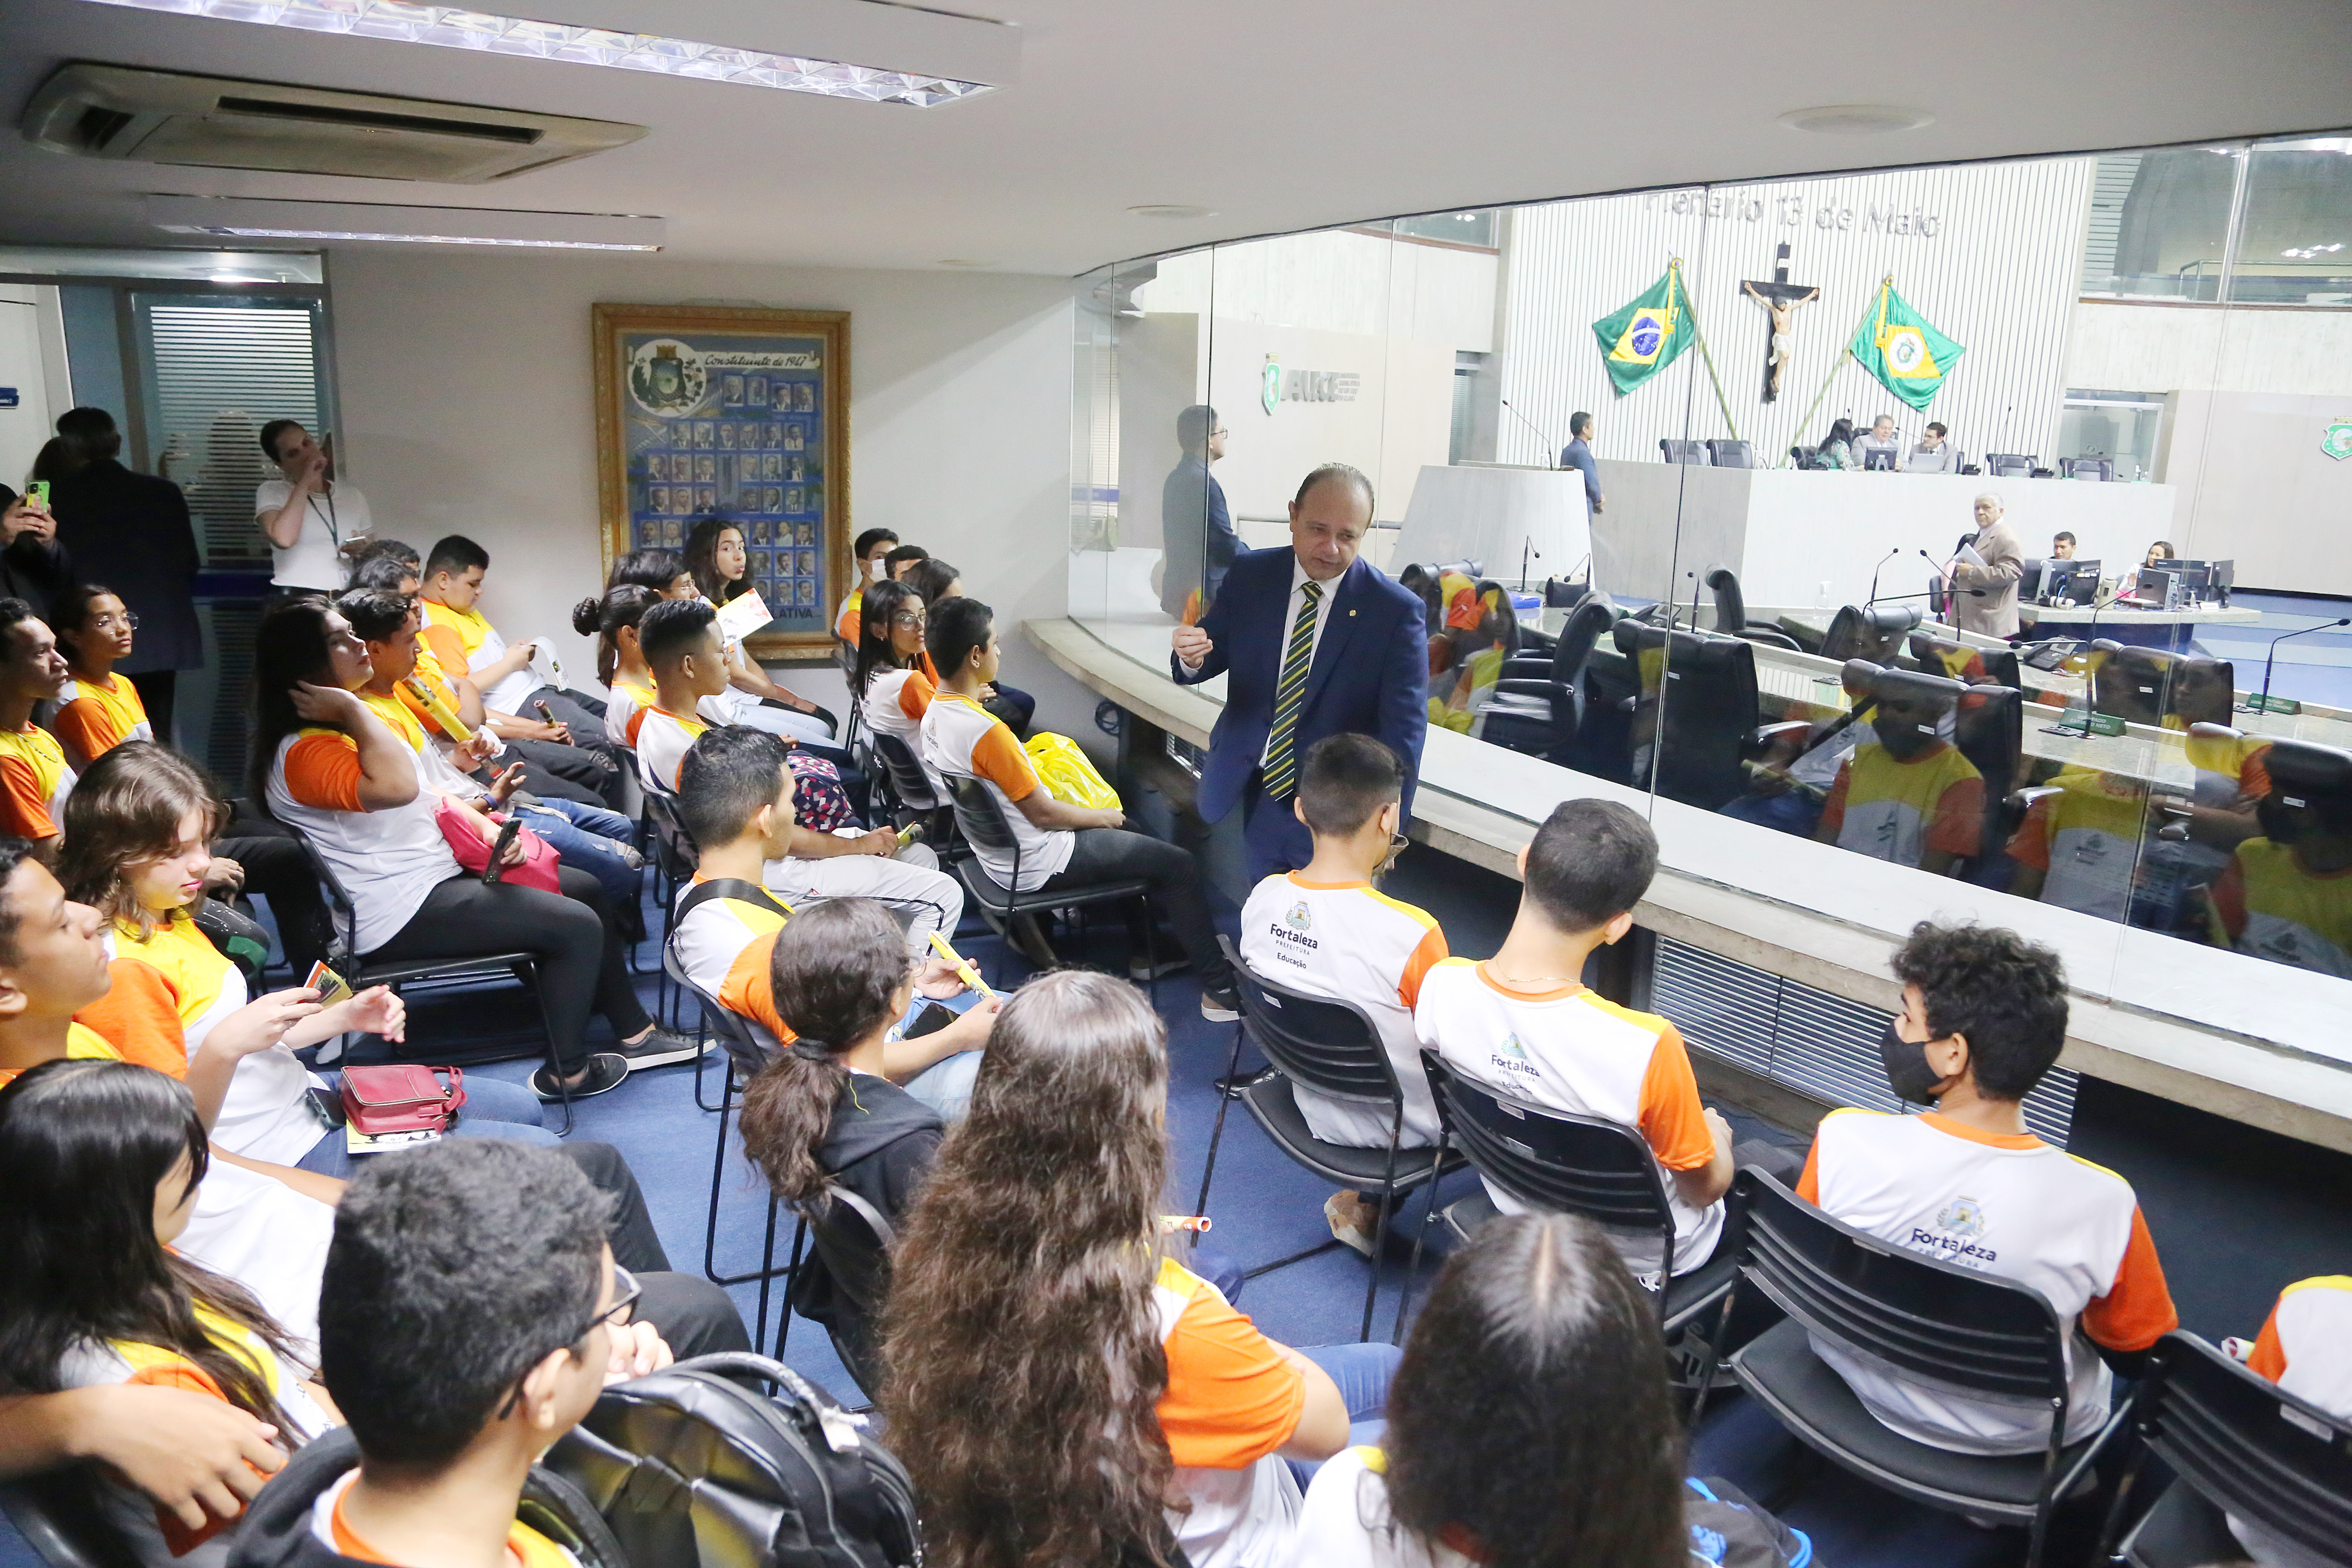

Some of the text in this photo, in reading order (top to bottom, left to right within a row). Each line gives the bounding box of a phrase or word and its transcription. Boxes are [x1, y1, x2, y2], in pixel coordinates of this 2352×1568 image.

[1776, 195, 1805, 226] 13
[1816, 197, 1853, 230] de
[1863, 202, 1941, 237] Maio
[773, 356, 784, 366] de
[785, 356, 807, 367] 1947
[772, 608, 813, 618] LATIVA
[1271, 924, 1318, 949] Fortaleza
[1275, 940, 1311, 956] PREFEITURA
[1277, 952, 1307, 969] Educação
[1491, 1054, 1540, 1077] Fortaleza
[1911, 1228, 1997, 1262] Fortaleza
[1919, 1247, 1979, 1268] PREFURA
